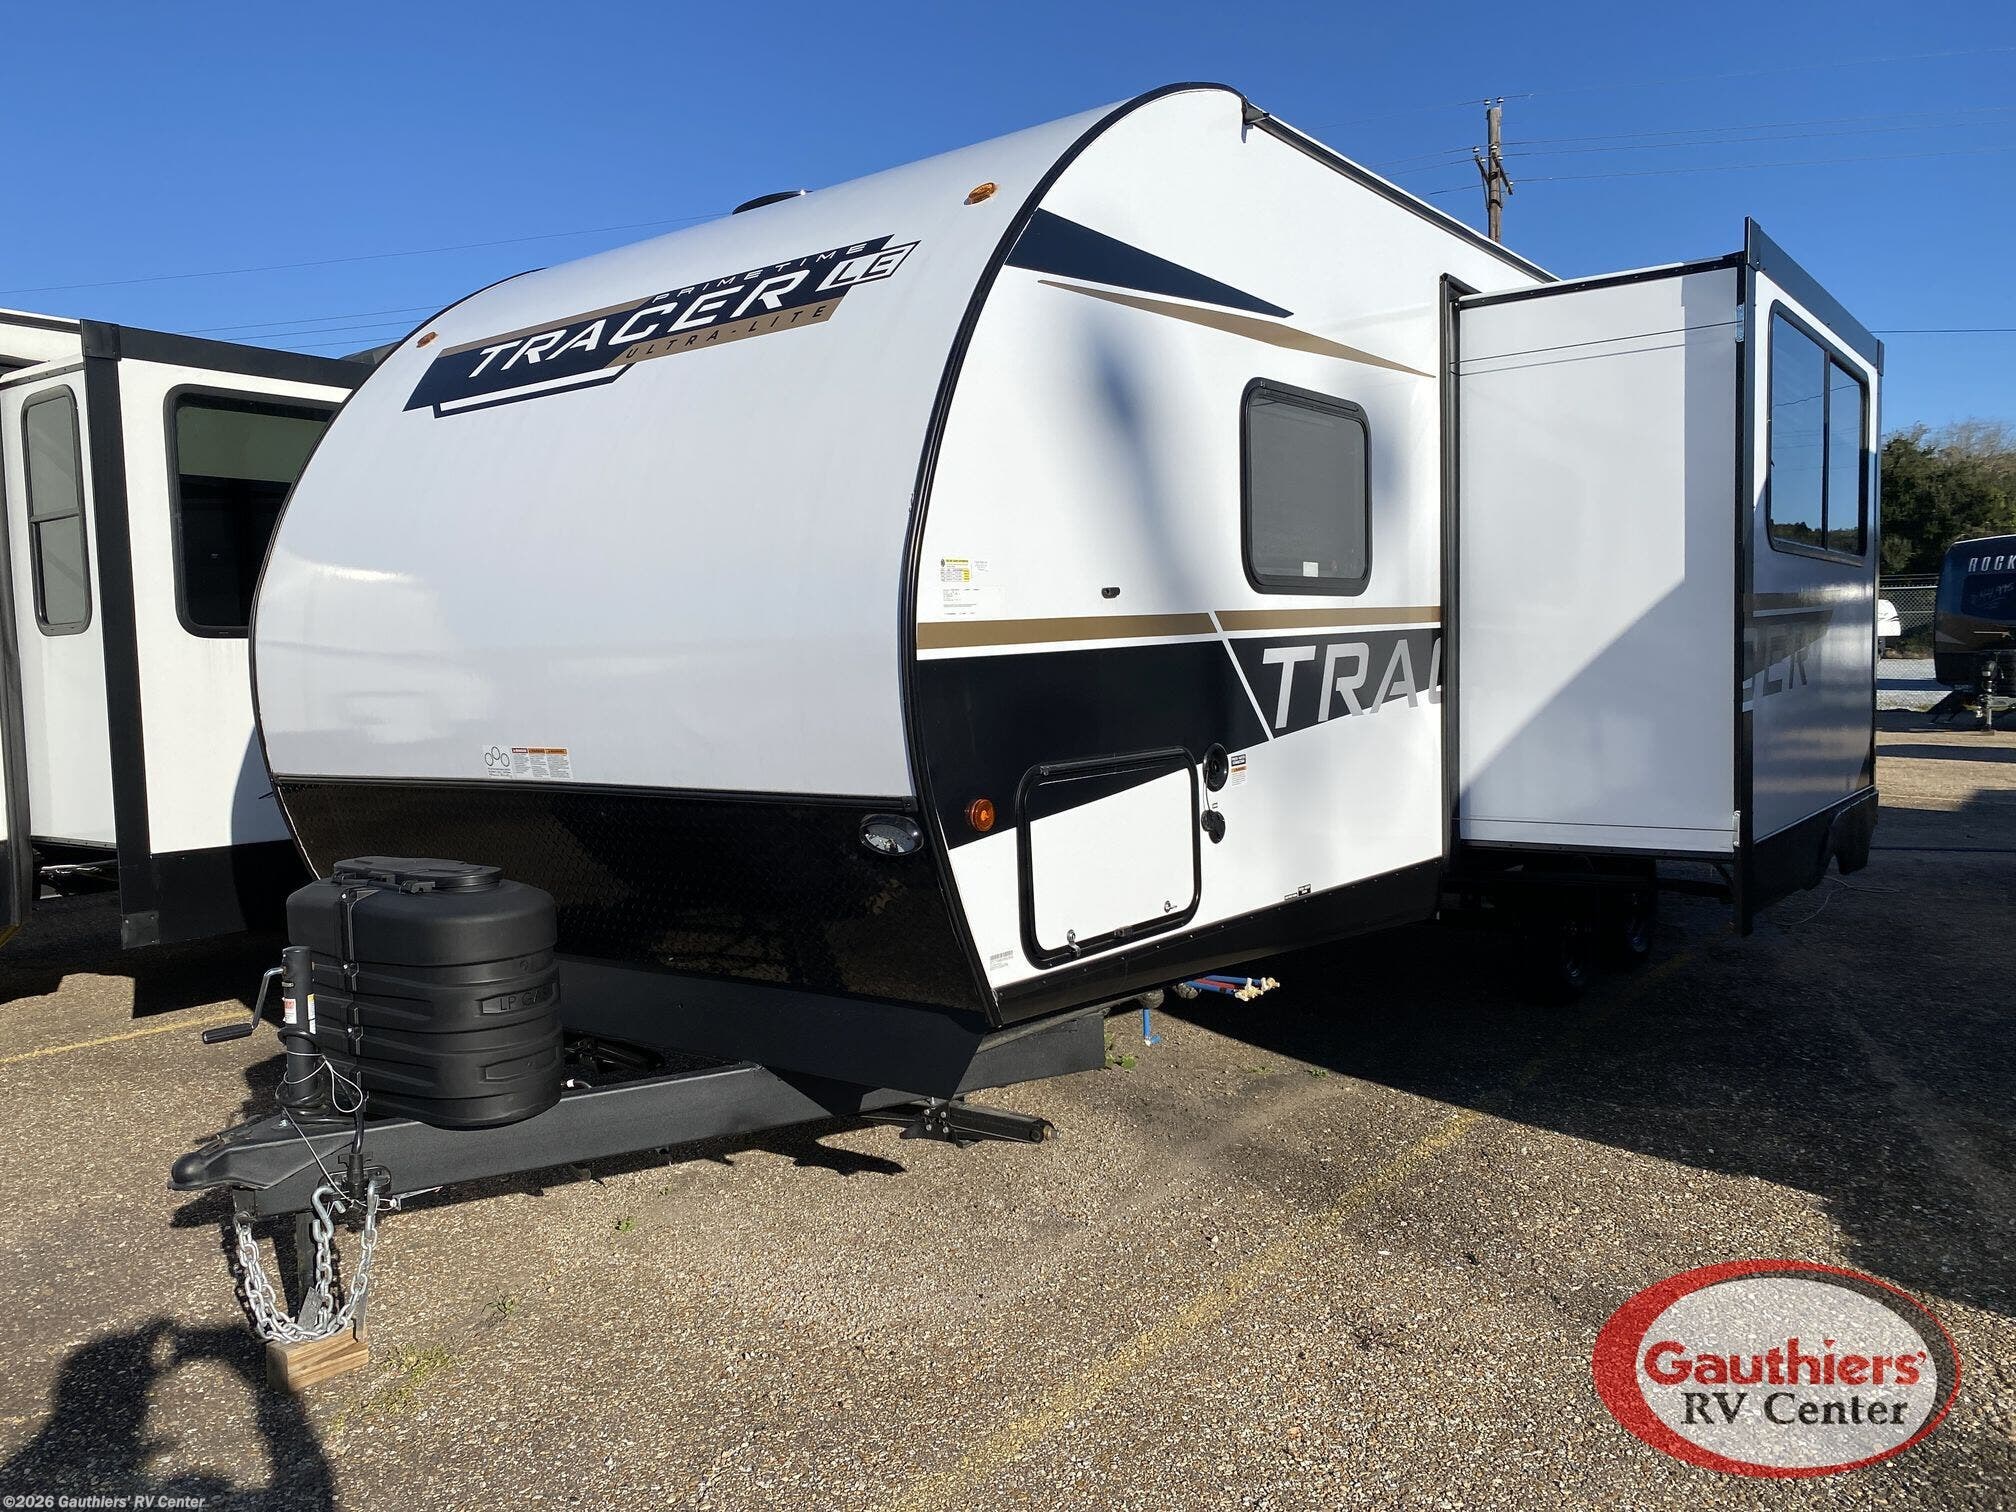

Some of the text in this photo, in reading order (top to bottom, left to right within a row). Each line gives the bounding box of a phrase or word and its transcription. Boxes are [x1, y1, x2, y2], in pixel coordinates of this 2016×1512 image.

[652, 243, 867, 303] PRIMETIME
[469, 240, 920, 378] TRACER LE
[626, 306, 826, 358] ULTRA-LITE
[500, 995, 516, 1010] LP
